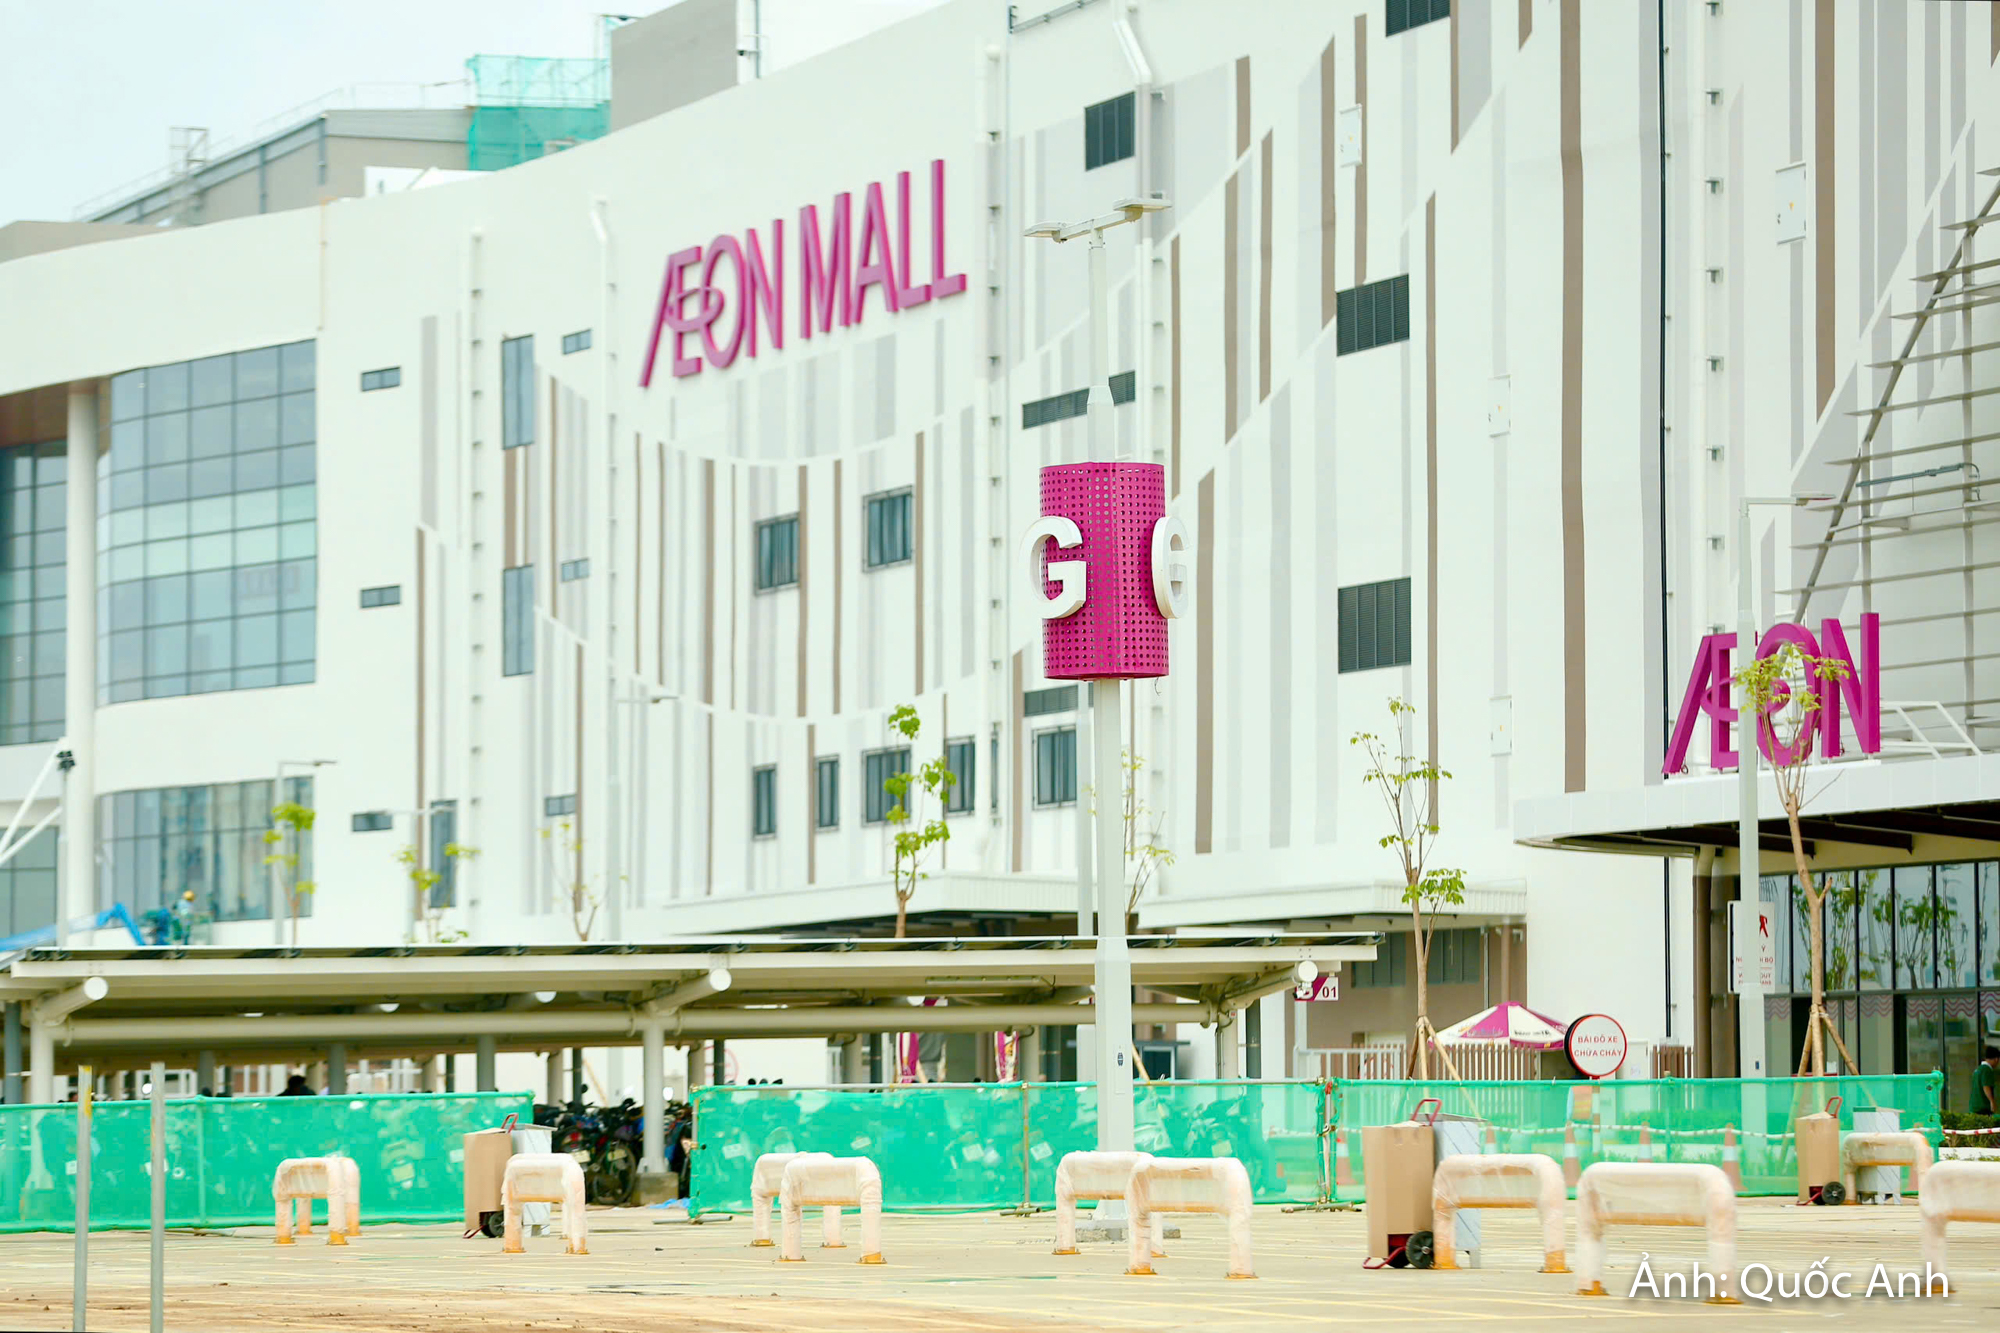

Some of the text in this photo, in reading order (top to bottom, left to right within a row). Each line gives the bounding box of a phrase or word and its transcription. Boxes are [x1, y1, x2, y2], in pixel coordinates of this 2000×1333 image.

[799, 158, 967, 339] MALL
[1019, 515, 1087, 619] G
[1322, 986, 1337, 999] 01
[1607, 1035, 1618, 1044] XE
